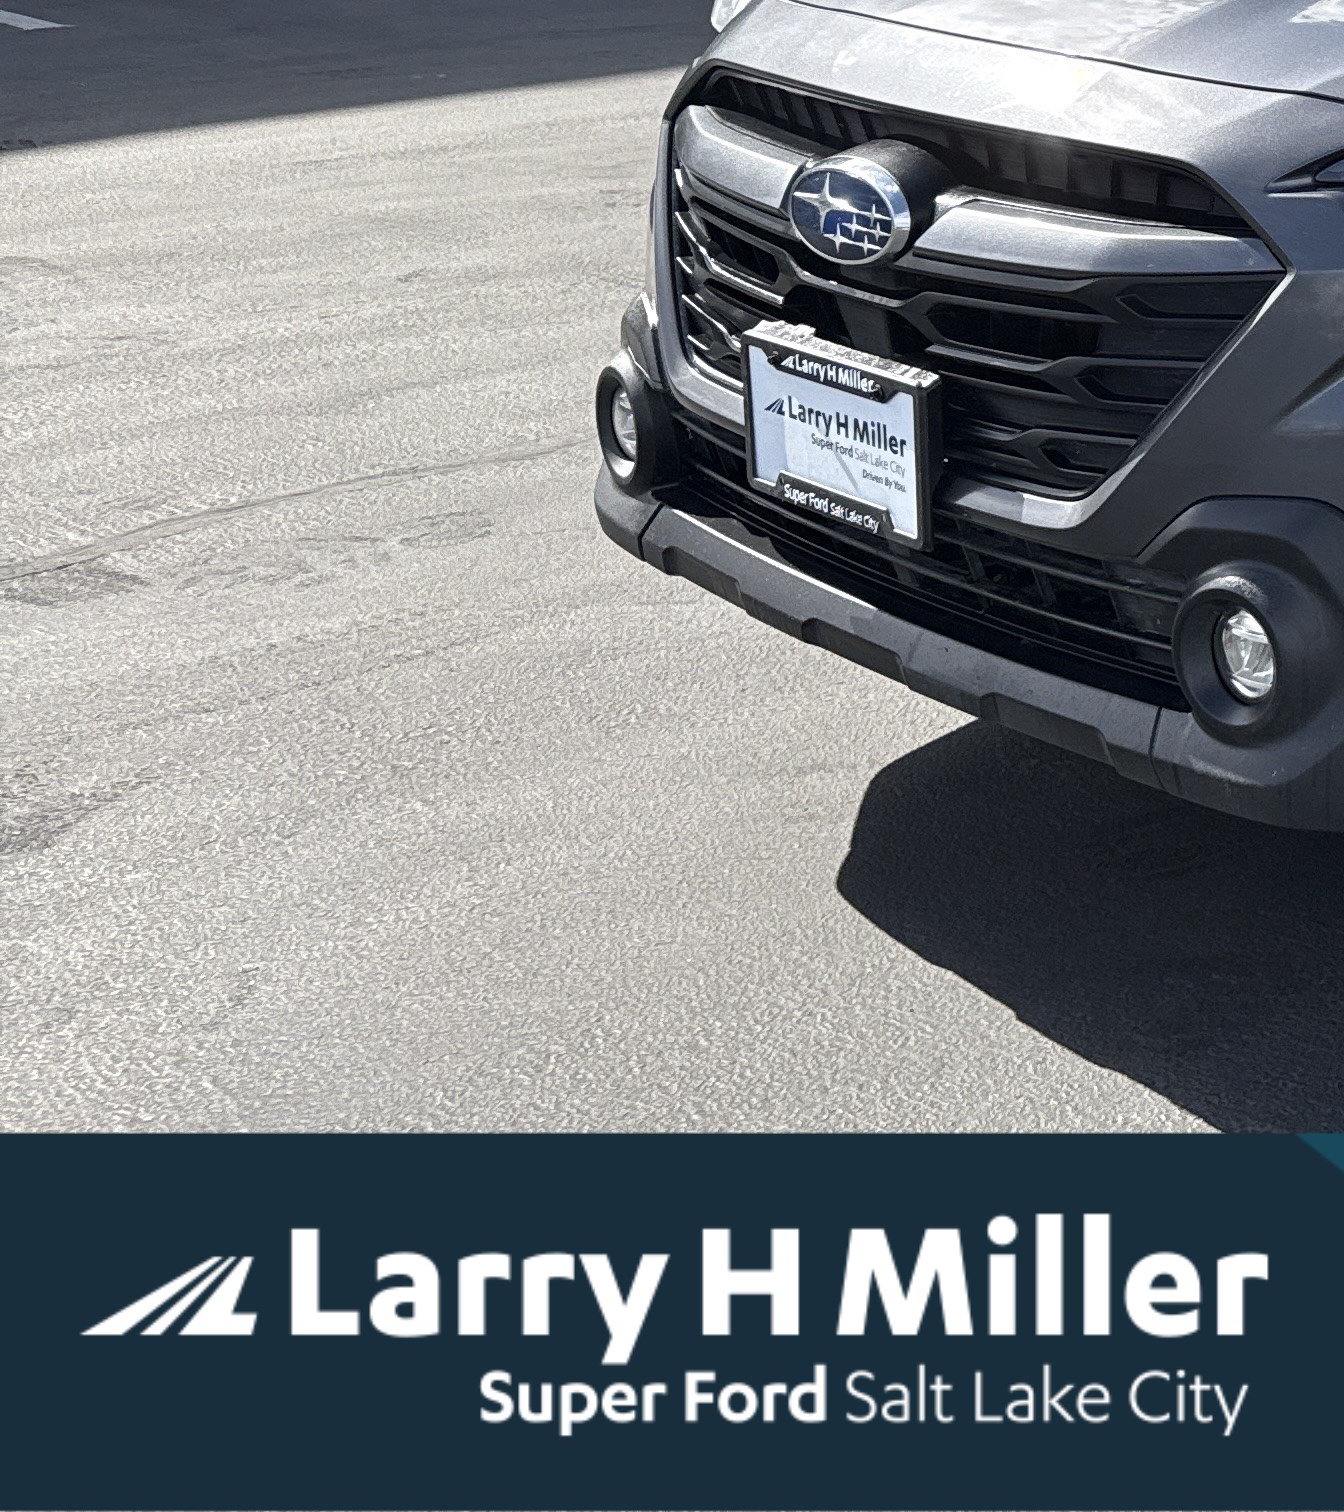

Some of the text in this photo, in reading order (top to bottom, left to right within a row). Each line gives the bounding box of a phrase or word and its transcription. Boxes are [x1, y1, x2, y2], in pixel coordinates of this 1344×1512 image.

[796, 354, 875, 393] Larry H Miller
[788, 394, 907, 457] Larry H Miller
[811, 432, 906, 478] Super Ford Salt Lake City
[783, 483, 880, 534] Super Ford Salt Lake City
